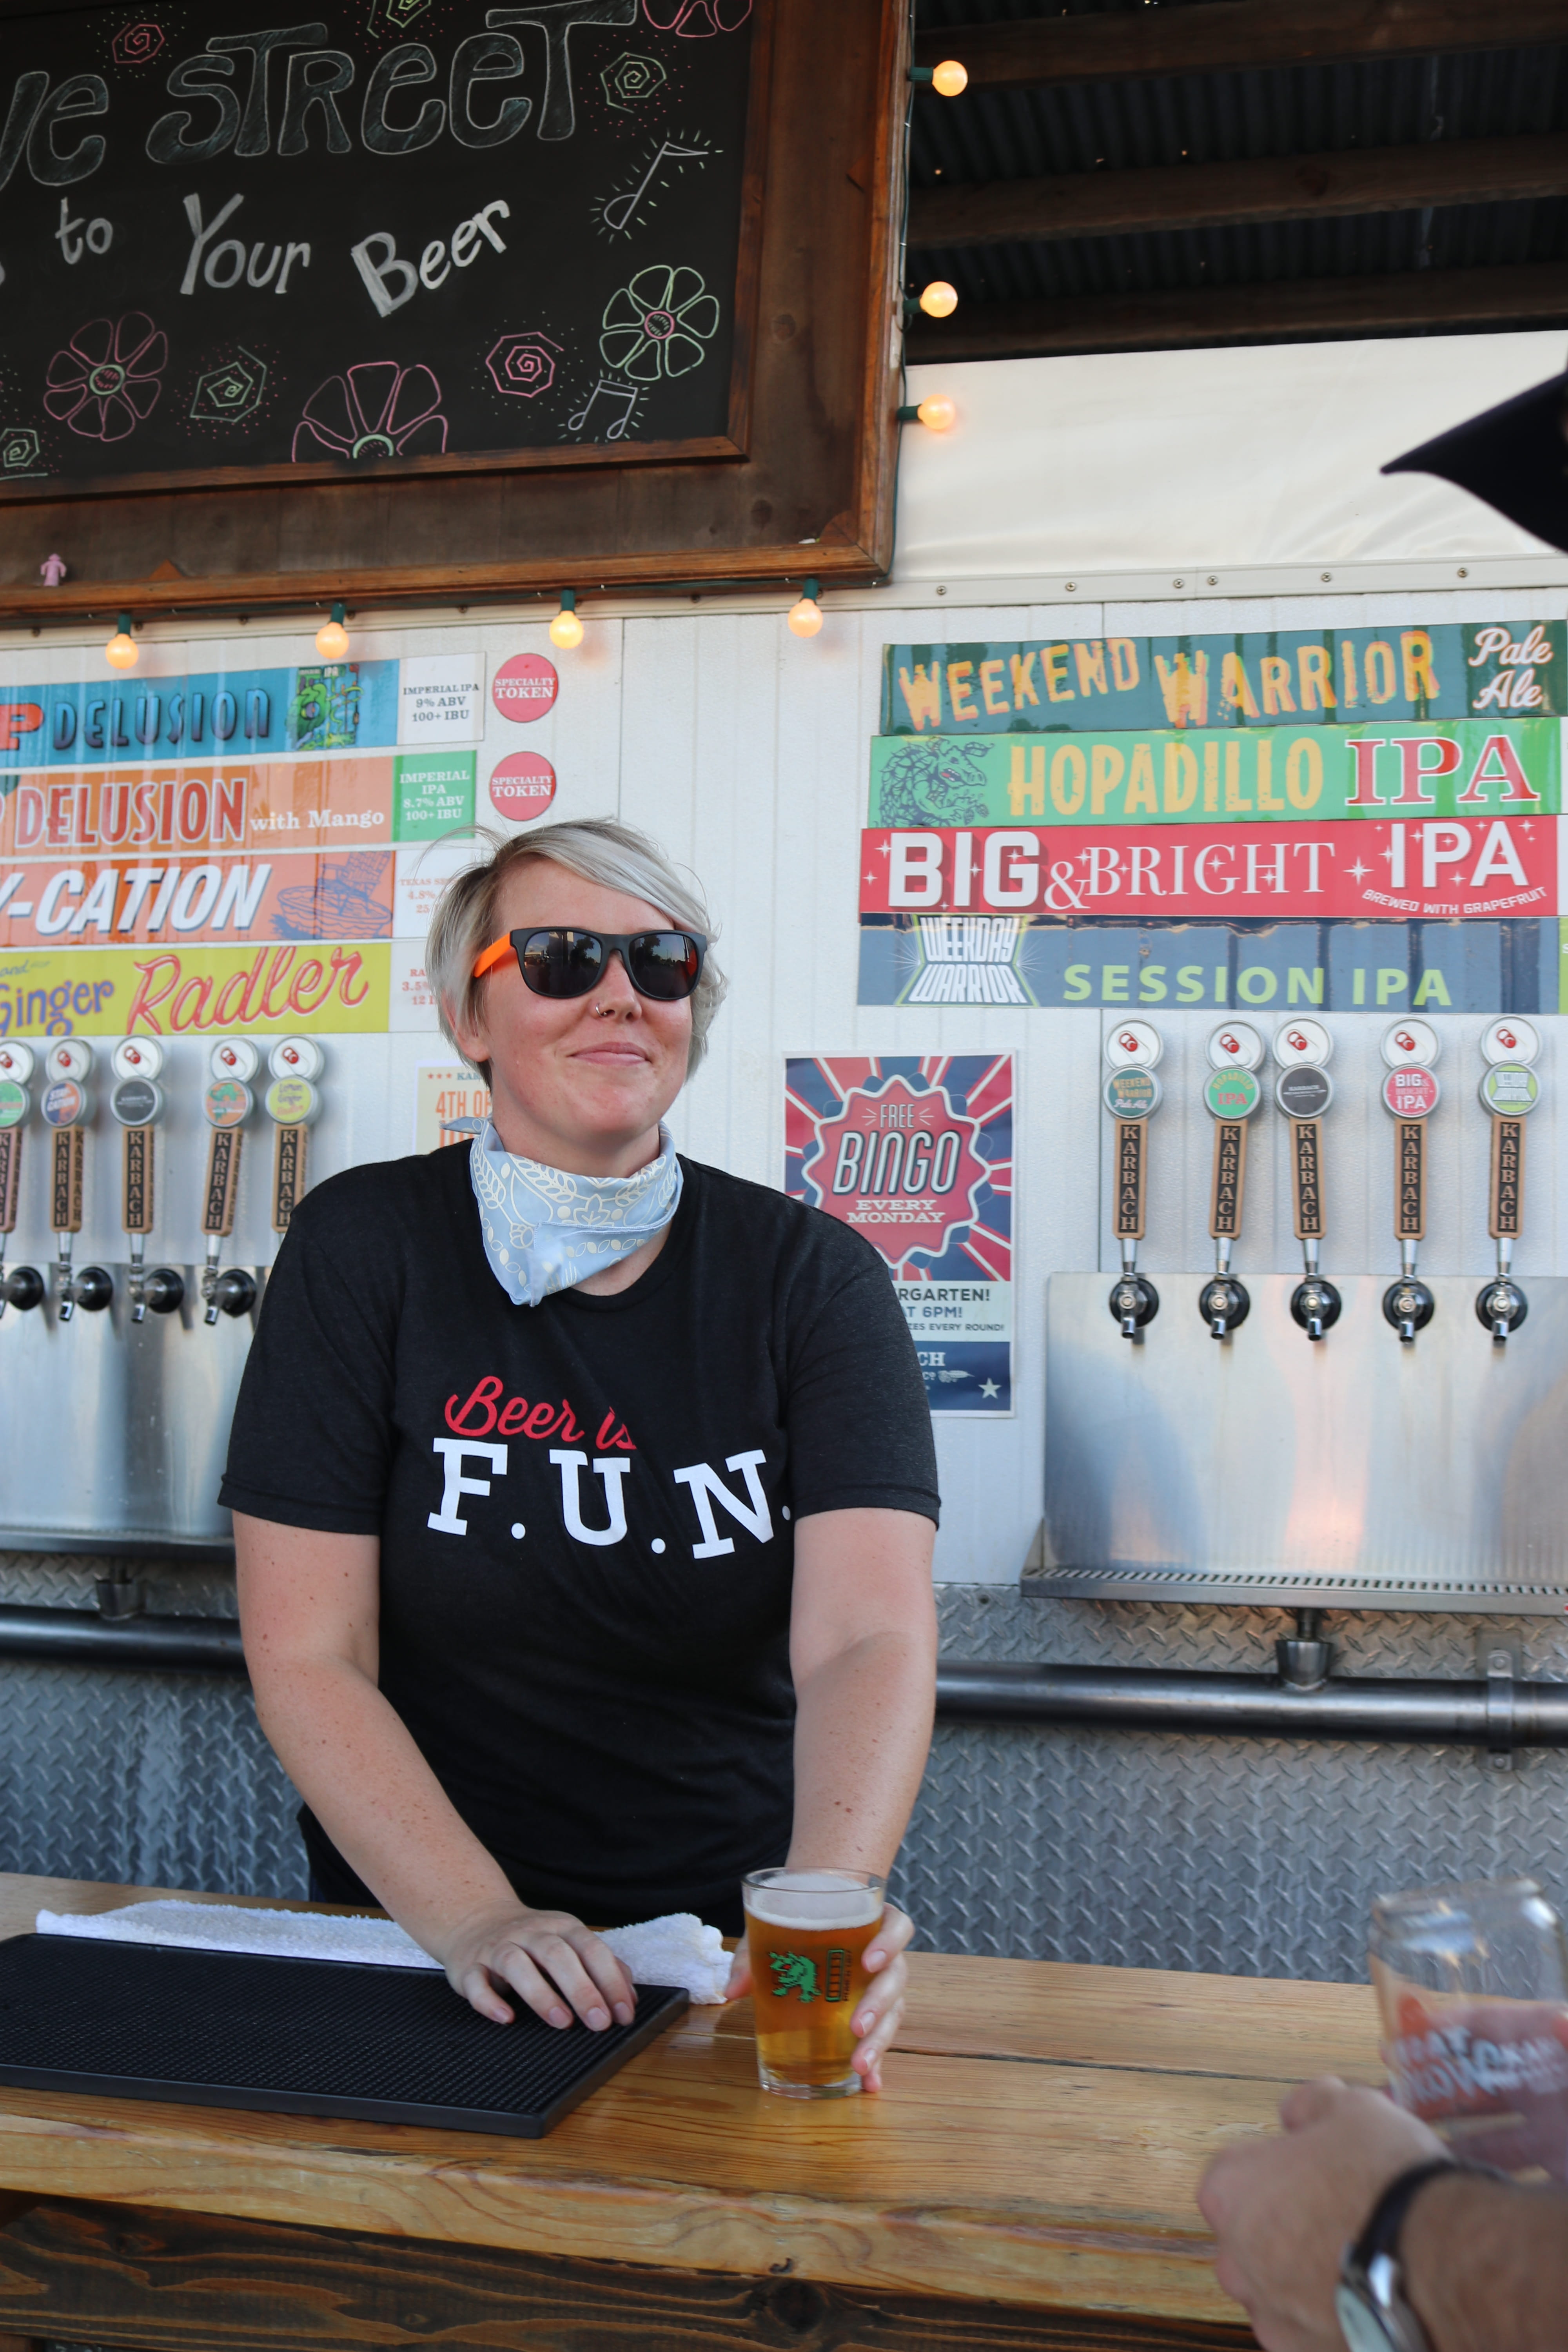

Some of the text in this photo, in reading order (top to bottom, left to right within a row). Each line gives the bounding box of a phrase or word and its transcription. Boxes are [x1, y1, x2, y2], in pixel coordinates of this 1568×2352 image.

[55, 193, 510, 318] to Your Beer
[1468, 625, 1553, 667] Pale
[403, 683, 479, 695] IMPERIAL IPA
[495, 677, 555, 687] SPECIALTY
[495, 687, 554, 699] TOKEN
[899, 630, 1440, 731] WEEKEND WARRIOR
[1472, 668, 1543, 710] Ale
[53, 688, 270, 750] DELUSION
[412, 710, 470, 722] 100+ IBU
[416, 696, 466, 708] 9% ABV
[399, 771, 470, 784] IMPERIAL
[421, 784, 447, 795] IPA
[492, 776, 553, 785] SPECIALTY
[493, 785, 552, 798] TOKEN
[1008, 735, 1541, 815] HOPADILLO IPA
[15, 778, 248, 848] DELUSION
[250, 812, 300, 831] with
[308, 809, 384, 829] Mango
[405, 809, 462, 821] 100+ IBU
[436, 796, 465, 807] ABV
[888, 821, 1529, 910] BIG & BRIGHT IPA
[416, 904, 428, 913] 25
[1362, 886, 1548, 914] BREWED WITH GRAPEFRUIT
[920, 917, 1019, 962] WEEKDAY
[126, 946, 369, 1036] Radler
[413, 996, 425, 1005] 12
[908, 964, 1028, 1003] WARRIOR
[1063, 964, 1452, 1006] SESSION IPA
[1218, 1093, 1248, 1105] IPA
[1396, 1074, 1421, 1087] BIG
[436, 1091, 467, 1118] 4TH
[880, 1103, 915, 1128] FREE
[1397, 1095, 1427, 1109] IPA
[56, 1134, 69, 1225] KARBACH
[129, 1132, 143, 1226] KARBACH
[207, 1134, 229, 1227] KARBACH
[279, 1131, 296, 1224] KARBACH
[832, 1131, 962, 1195] BINGO
[1121, 1127, 1138, 1230] KARBACH
[1217, 1128, 1239, 1230] KARBACH
[1299, 1126, 1318, 1230] KARBACH
[1403, 1126, 1419, 1230] KARBACH
[1500, 1125, 1518, 1229] KARBACH
[846, 1212, 946, 1223] MONDAY
[855, 1199, 936, 1210] EVERY
[895, 1288, 990, 1301] RGARTEN!
[923, 1306, 962, 1318] 6PM!
[445, 1376, 637, 1450] Beer is
[427, 1437, 791, 1559] F.U.N.
